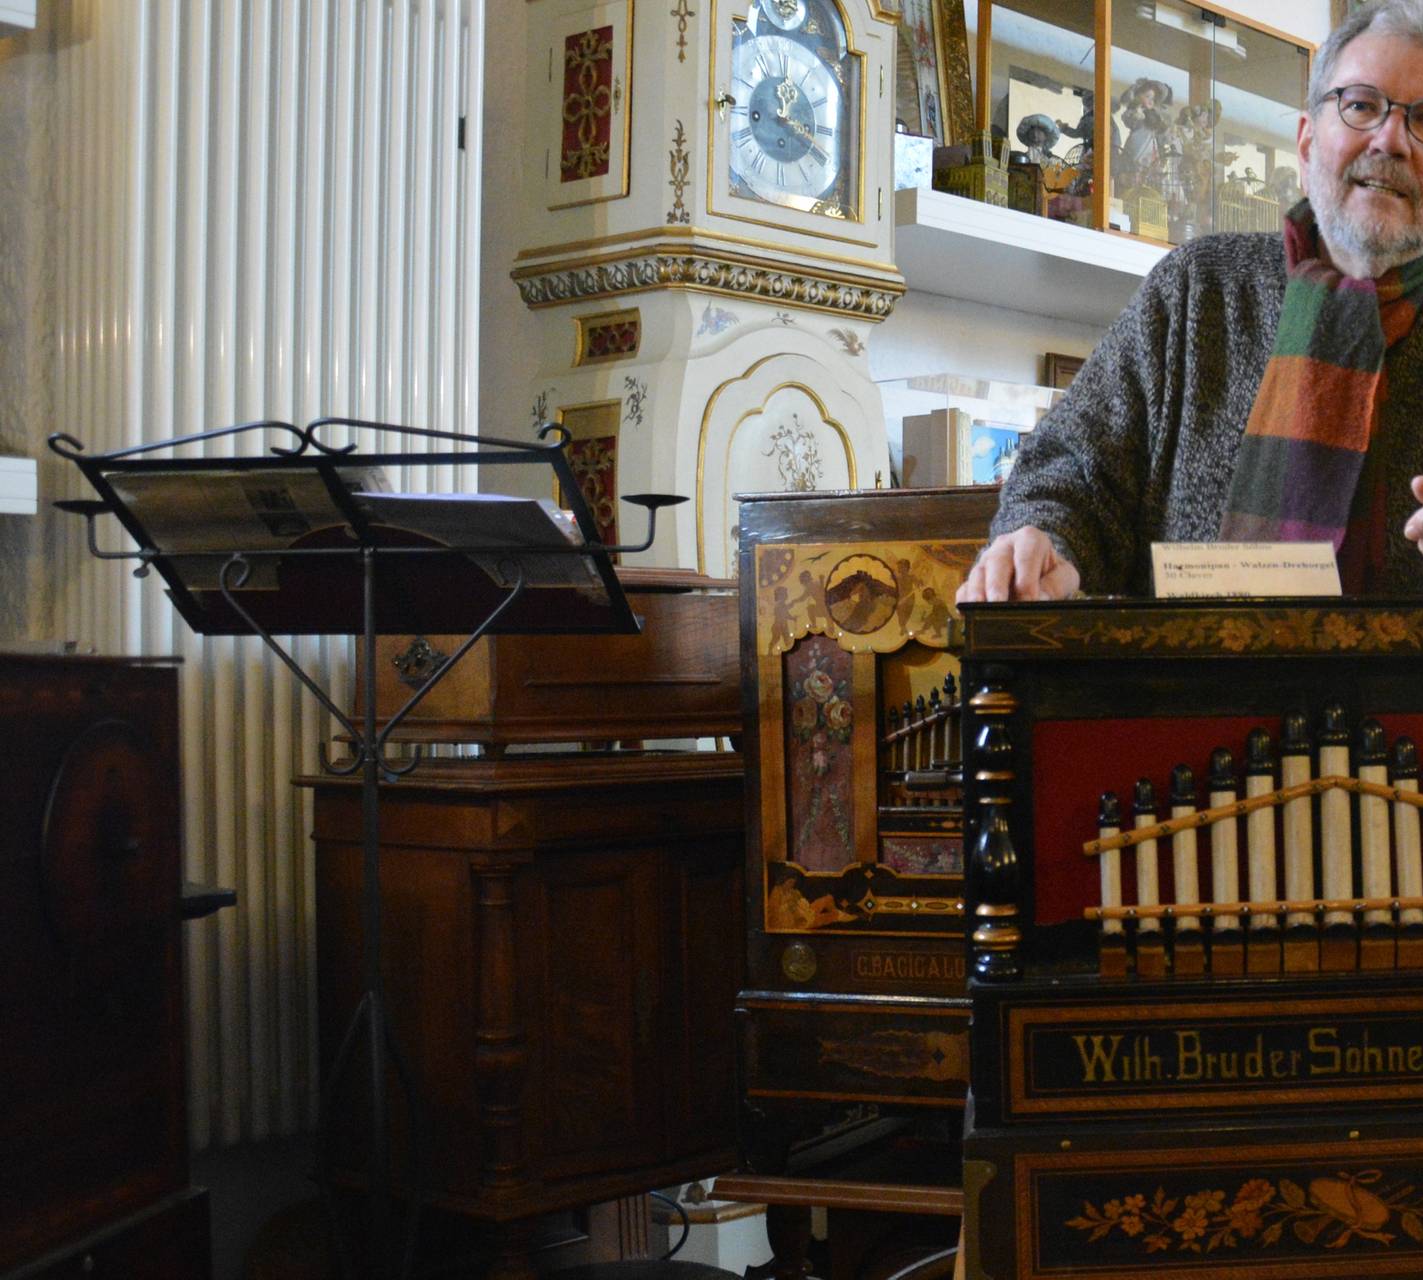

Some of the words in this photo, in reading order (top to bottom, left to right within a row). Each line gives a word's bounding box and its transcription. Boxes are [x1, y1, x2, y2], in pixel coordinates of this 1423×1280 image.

[1163, 562, 1230, 571] Harmonipan
[1072, 1034, 1173, 1083] Wilh.
[1175, 1029, 1301, 1081] Bruder
